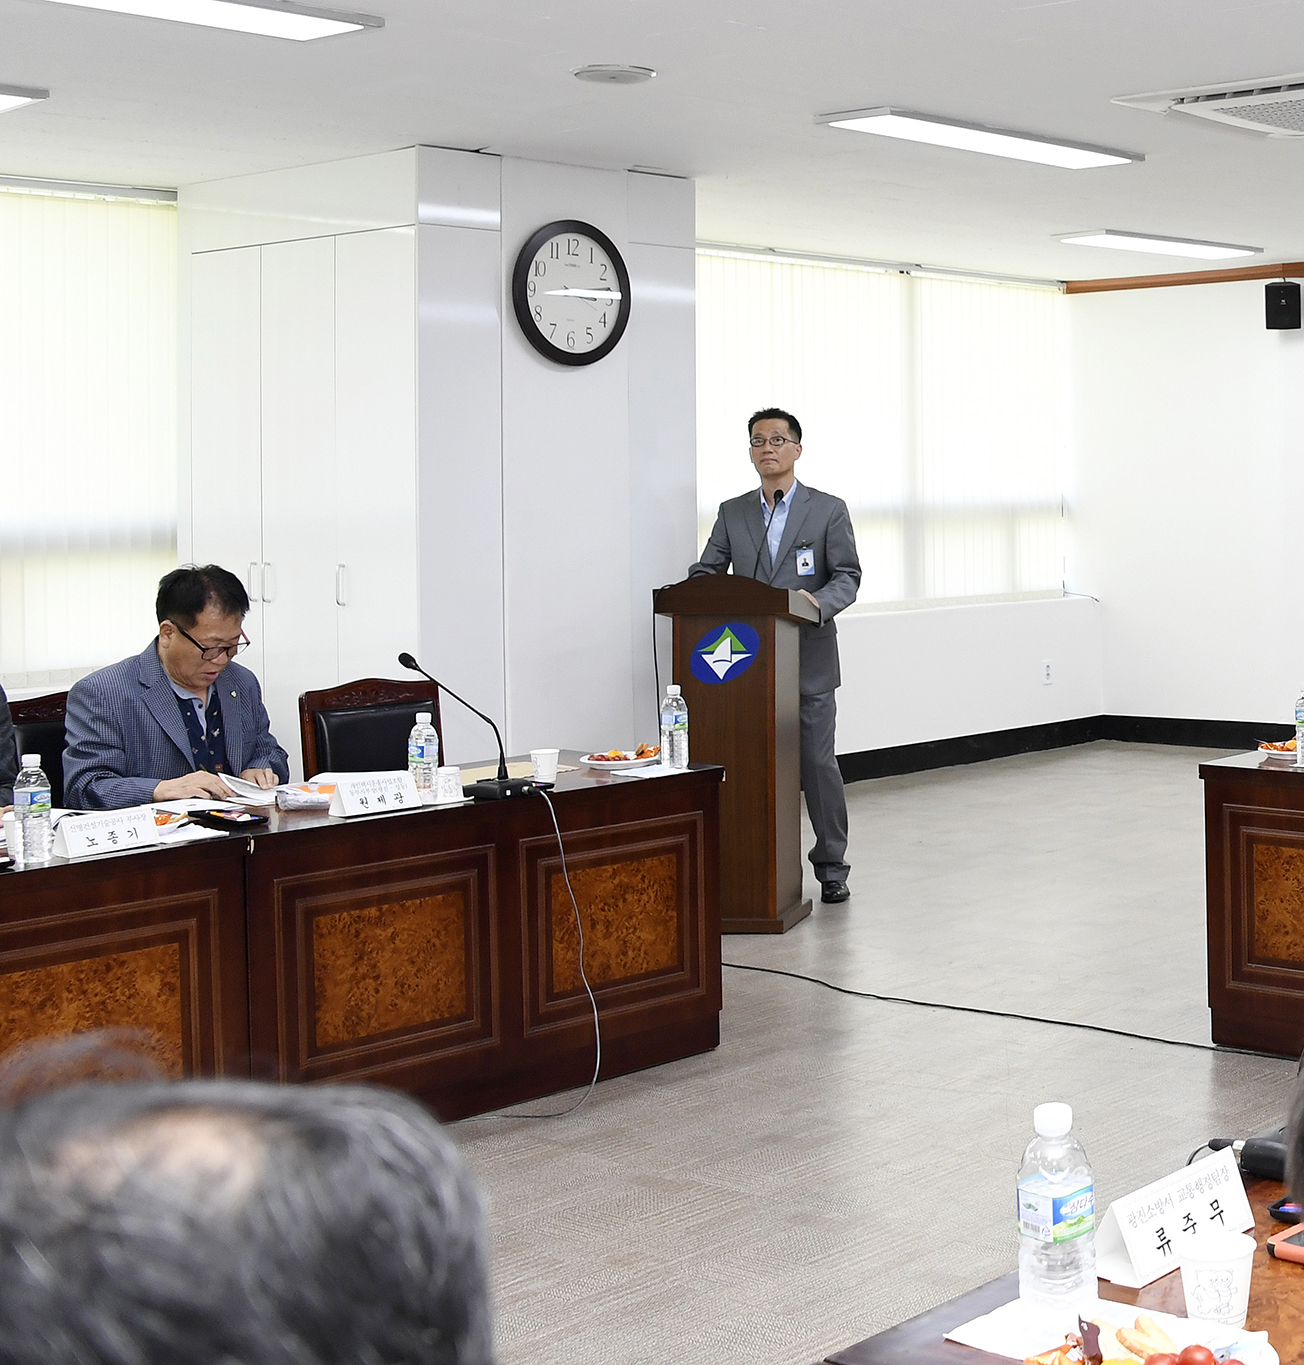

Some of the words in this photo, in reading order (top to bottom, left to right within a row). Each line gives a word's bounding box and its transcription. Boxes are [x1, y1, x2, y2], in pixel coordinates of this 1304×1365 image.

[550, 241, 560, 260] 11
[567, 239, 580, 257] 12
[589, 247, 594, 264] 1
[534, 260, 547, 278] 10
[599, 263, 608, 282] 2
[527, 280, 537, 298] 9
[534, 304, 543, 323] 8
[598, 312, 608, 329] 4
[549, 322, 558, 340] 7
[566, 330, 576, 348] 6
[585, 326, 594, 345] 5
[1127, 1193, 1175, 1229] 광진소방서
[1177, 1165, 1230, 1203] 교통행정팀장
